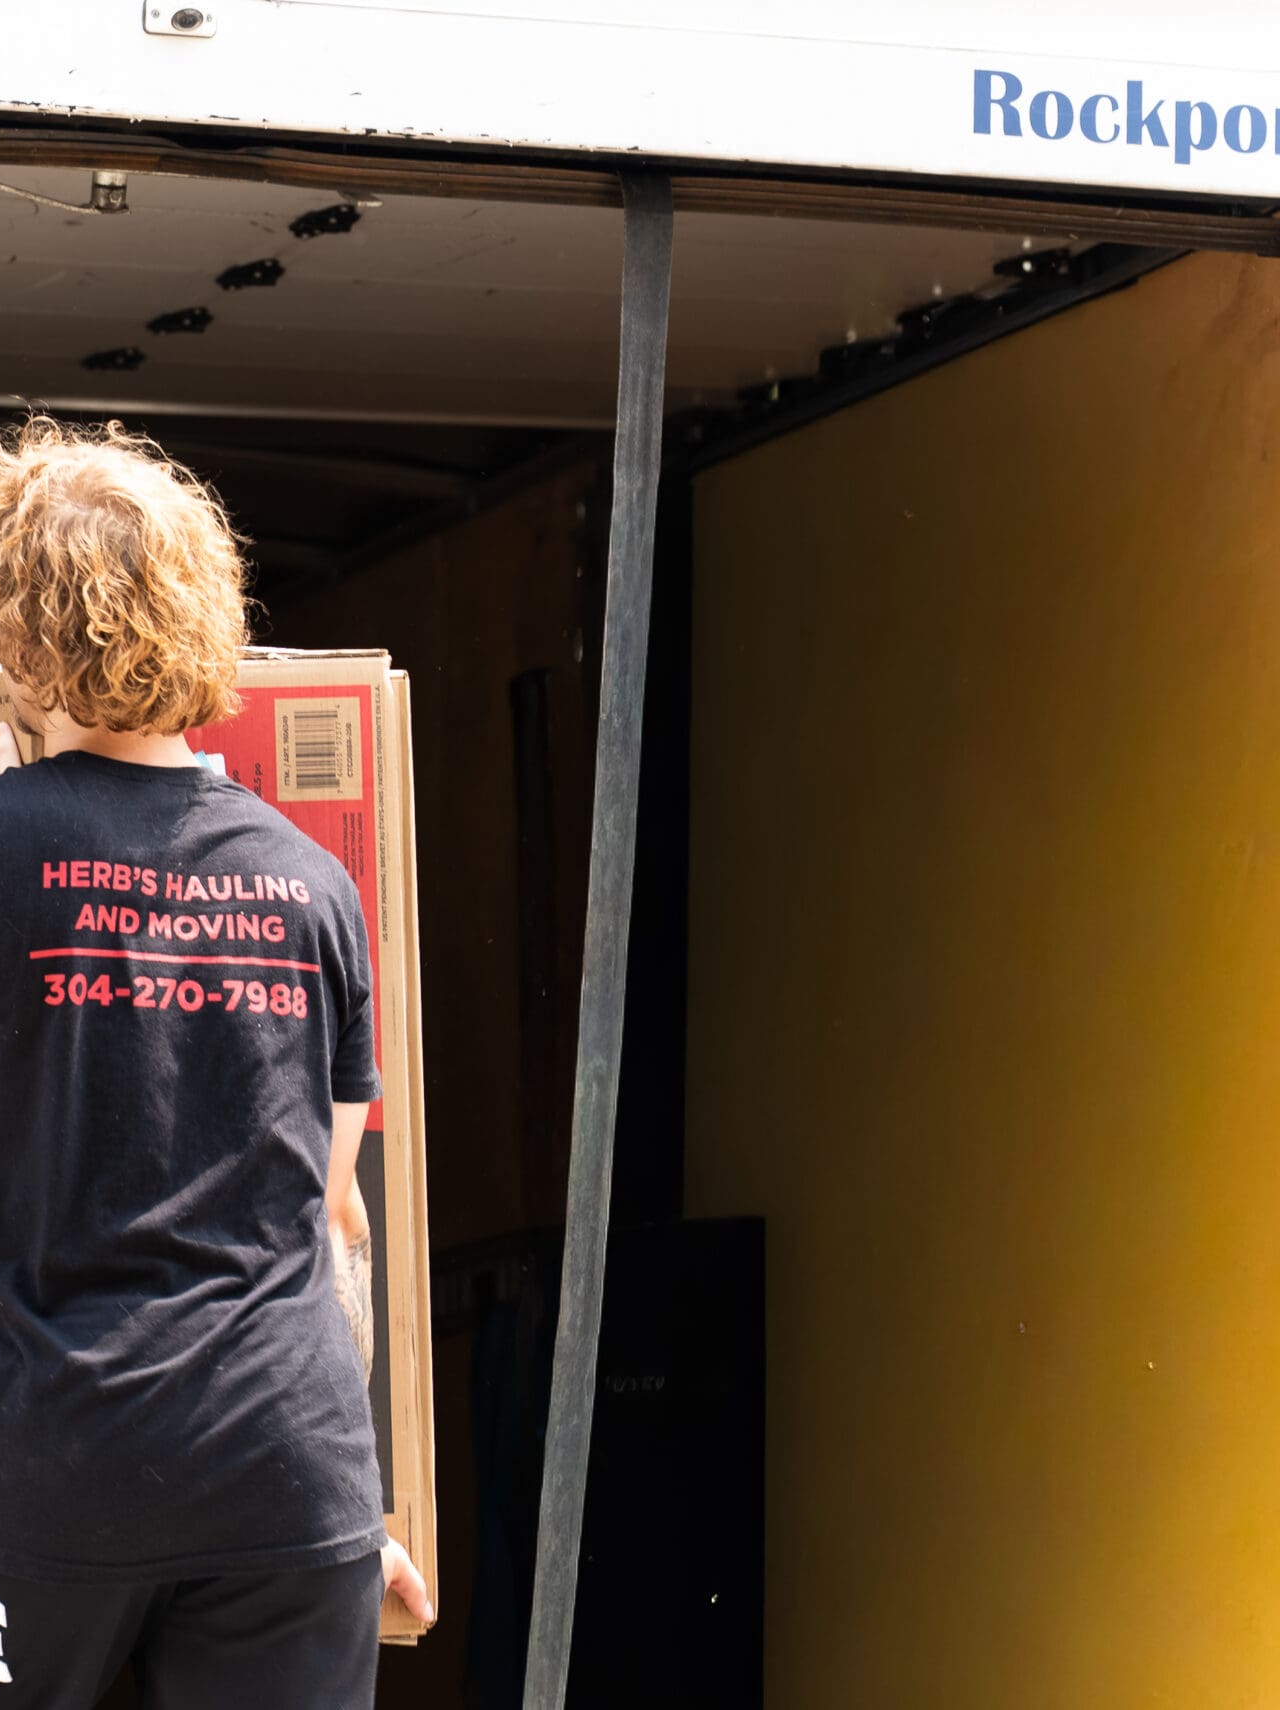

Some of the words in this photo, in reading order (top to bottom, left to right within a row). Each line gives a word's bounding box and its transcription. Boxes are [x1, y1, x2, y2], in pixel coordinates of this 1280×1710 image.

[973, 69, 1280, 165] Rockpo
[42, 861, 158, 897] HERB'S
[165, 872, 311, 904] HAULING
[74, 903, 140, 935] AND
[147, 911, 286, 943] MOVING
[43, 972, 308, 1020] 304-270-7988
